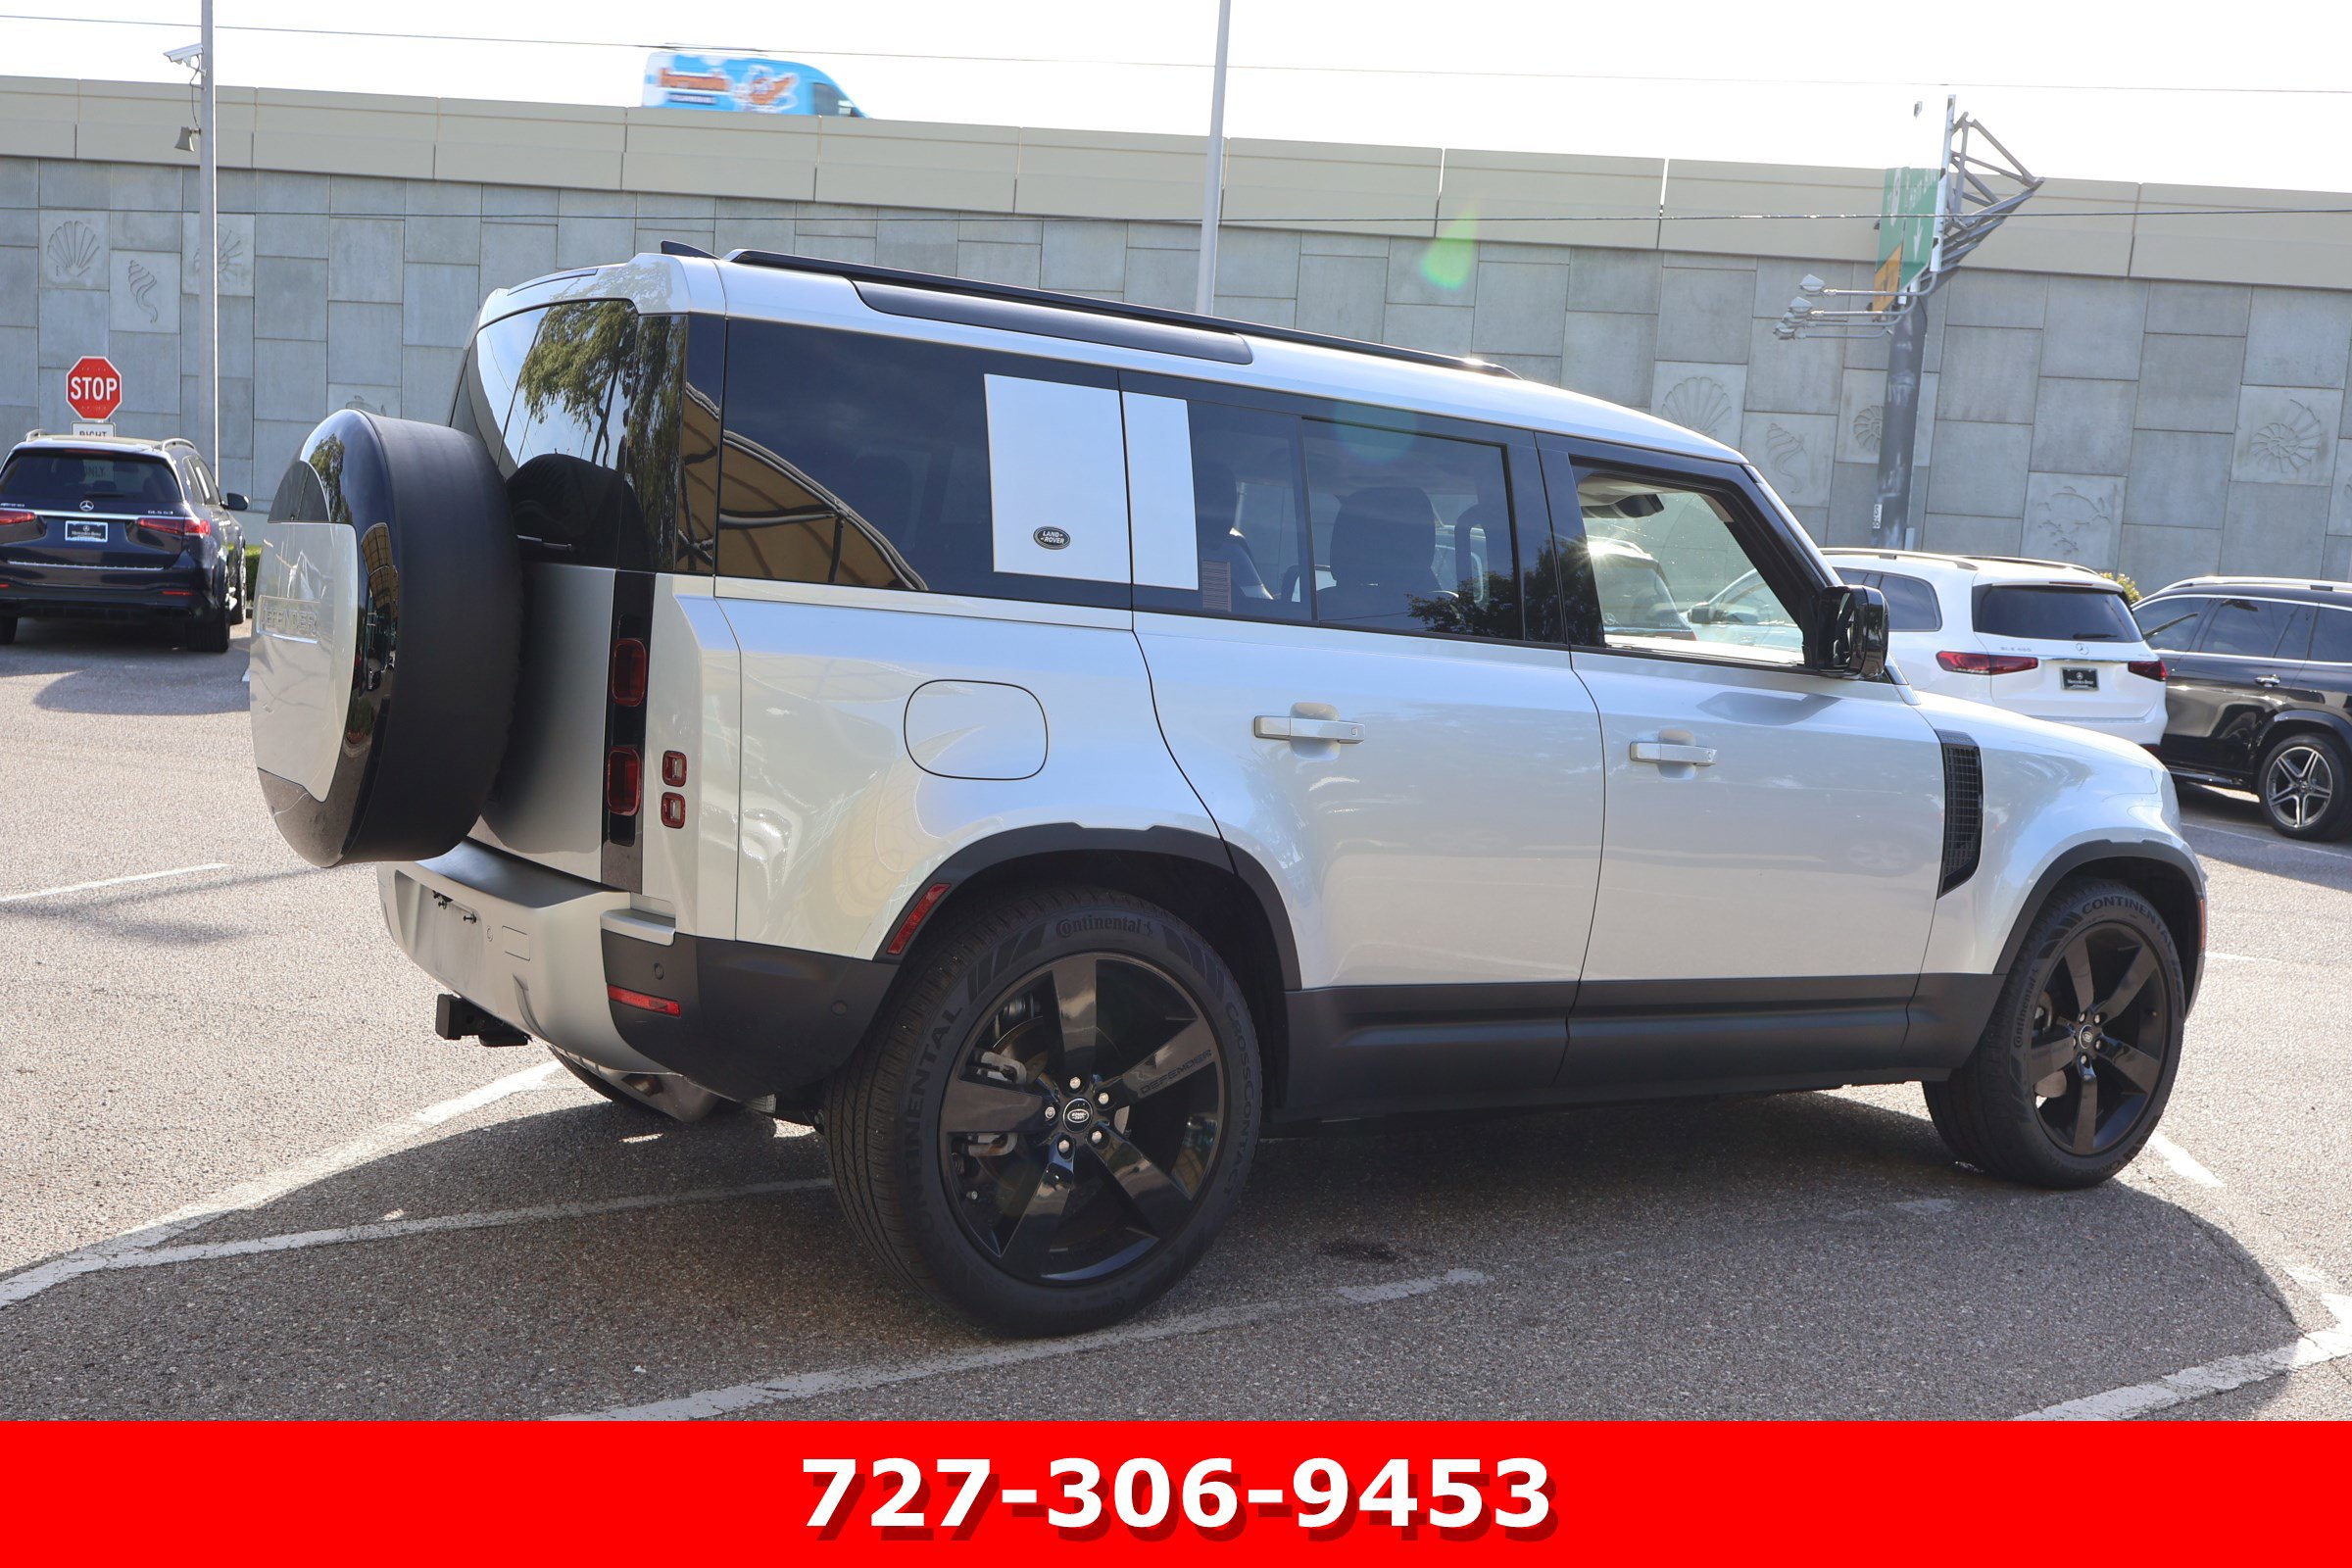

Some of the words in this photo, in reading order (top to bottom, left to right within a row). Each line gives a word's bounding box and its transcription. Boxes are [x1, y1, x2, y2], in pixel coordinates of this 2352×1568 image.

[71, 376, 119, 401] STOP
[1055, 917, 1143, 939] Continental
[2082, 895, 2173, 954] CONTINENTAL
[2014, 977, 2035, 1049] Continental
[1140, 1048, 1212, 1095] DEFENDER
